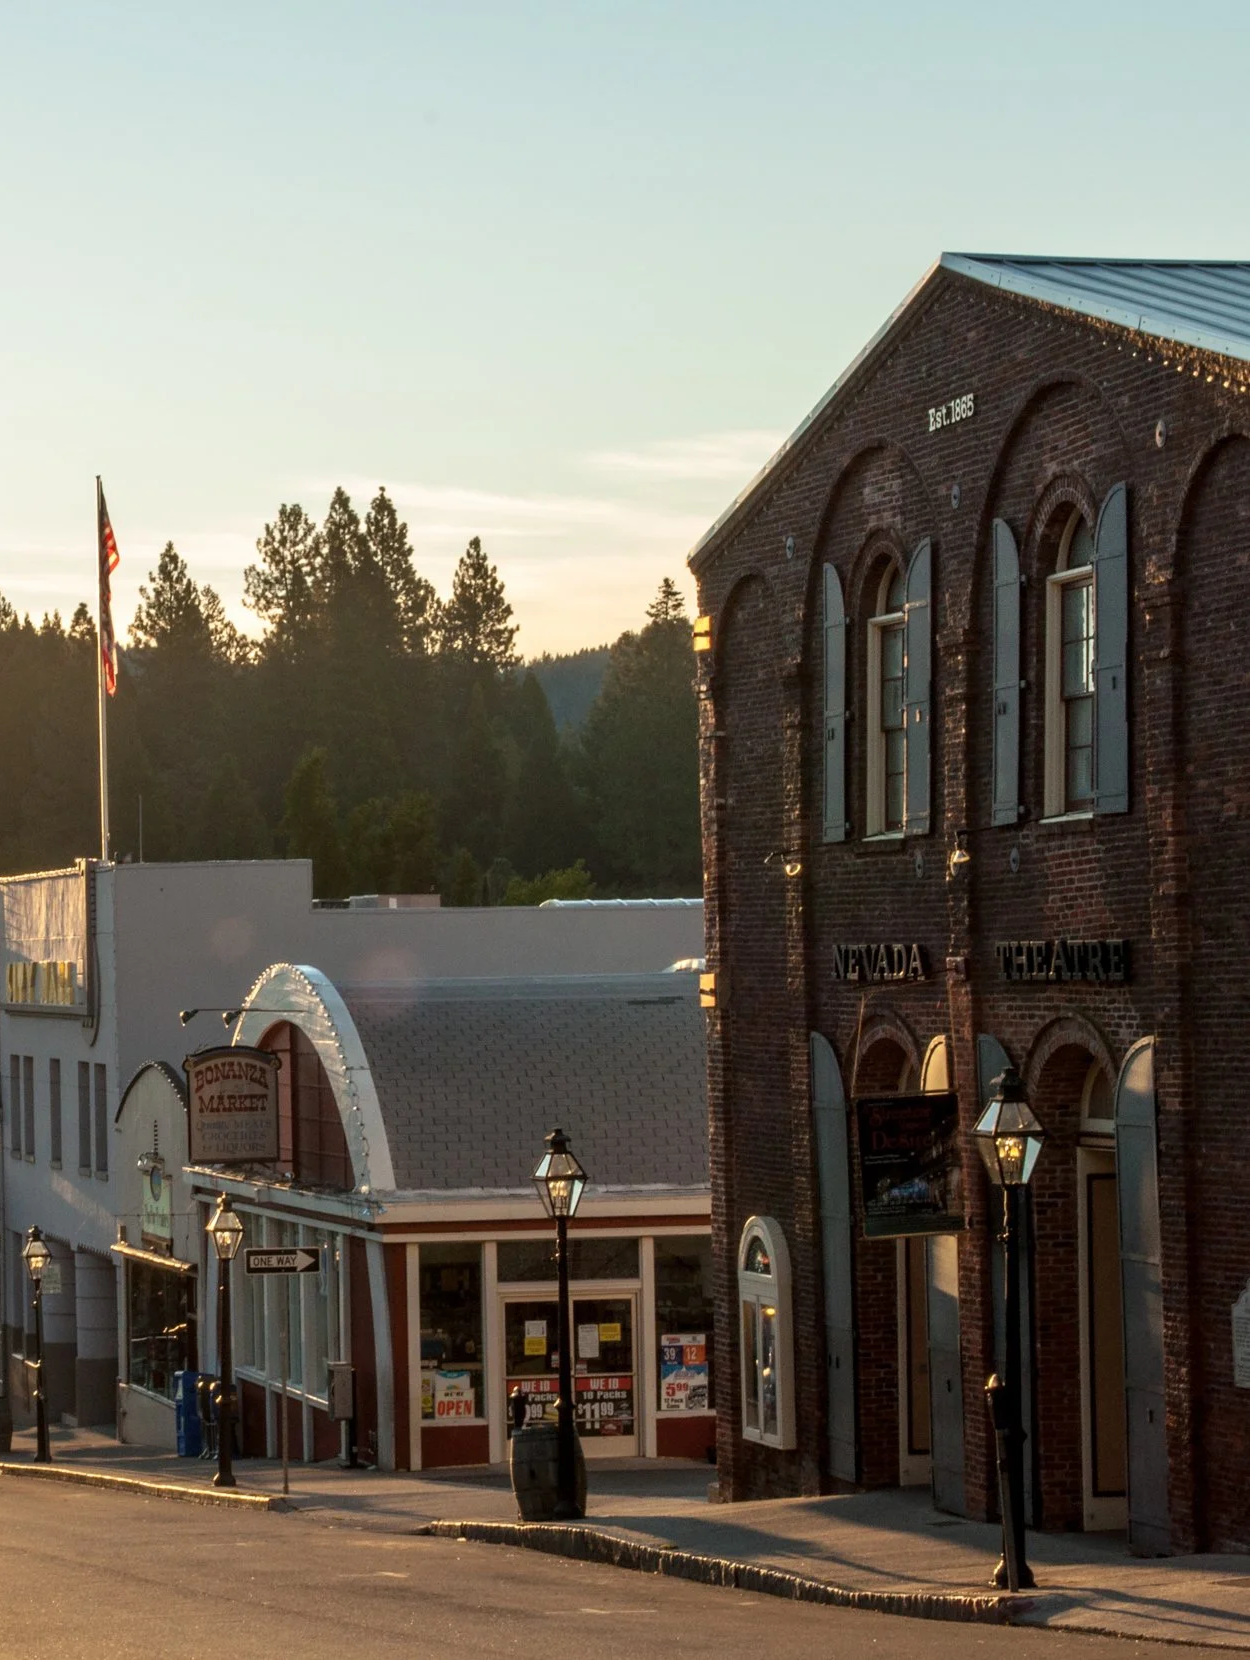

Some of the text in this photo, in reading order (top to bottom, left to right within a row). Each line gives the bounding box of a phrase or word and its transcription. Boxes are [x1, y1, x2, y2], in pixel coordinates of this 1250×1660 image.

[832, 938, 1126, 981] NEVADA THEATRE
[194, 1061, 270, 1093] BONANZA
[198, 1094, 269, 1113] MARKET
[253, 1255, 297, 1267] ONE WAY
[521, 1380, 551, 1392] WE ID
[590, 1377, 619, 1390] WE ID
[596, 1390, 628, 1400] Packs
[437, 1400, 473, 1417] OPEN
